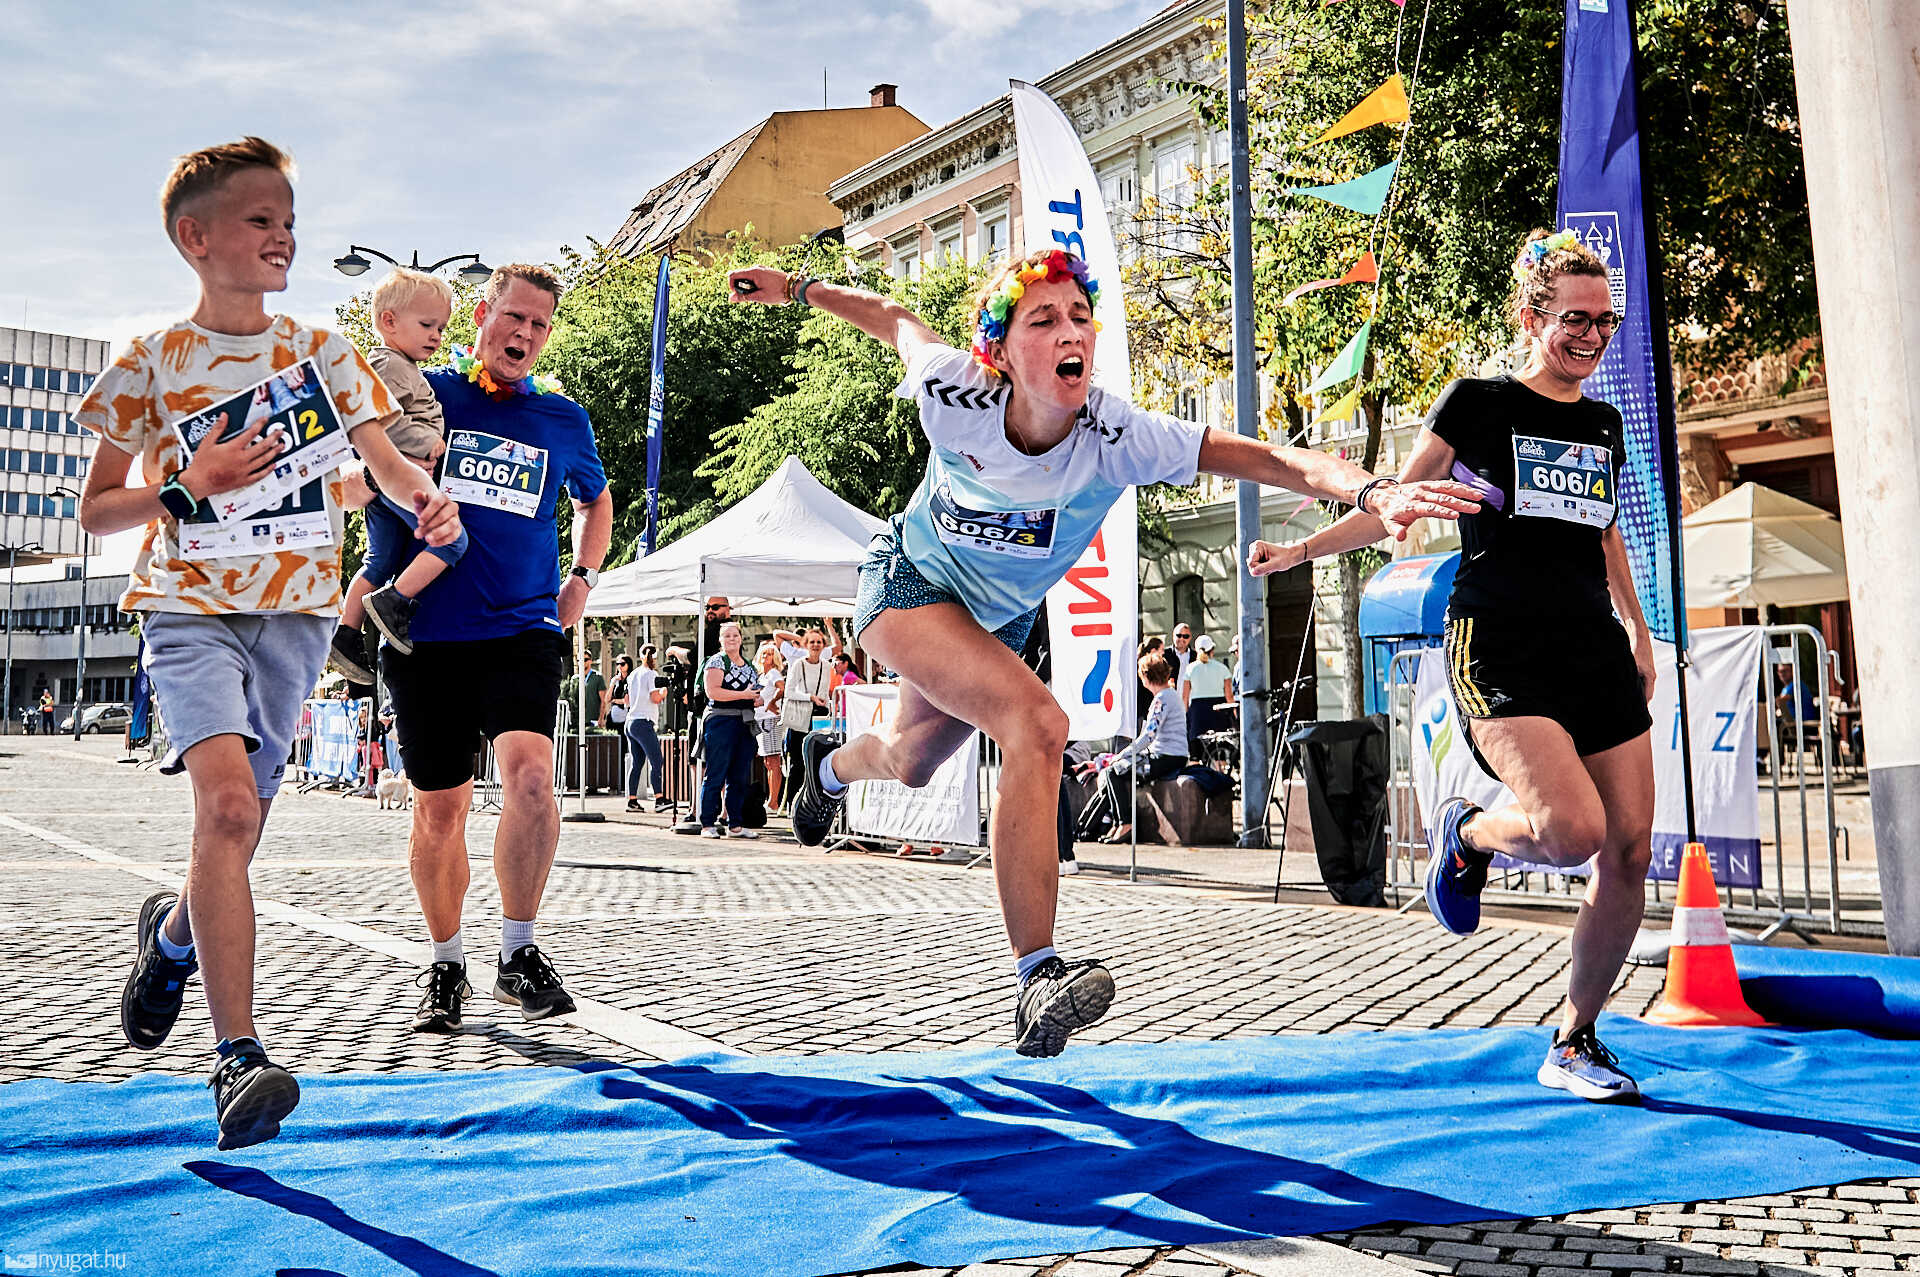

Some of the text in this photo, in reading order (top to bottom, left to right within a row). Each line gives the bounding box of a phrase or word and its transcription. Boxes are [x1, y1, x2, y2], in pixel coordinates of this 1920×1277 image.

[458, 456, 530, 490] 606/1
[1532, 466, 1606, 499] 606/4
[940, 512, 1036, 545] 606/3
